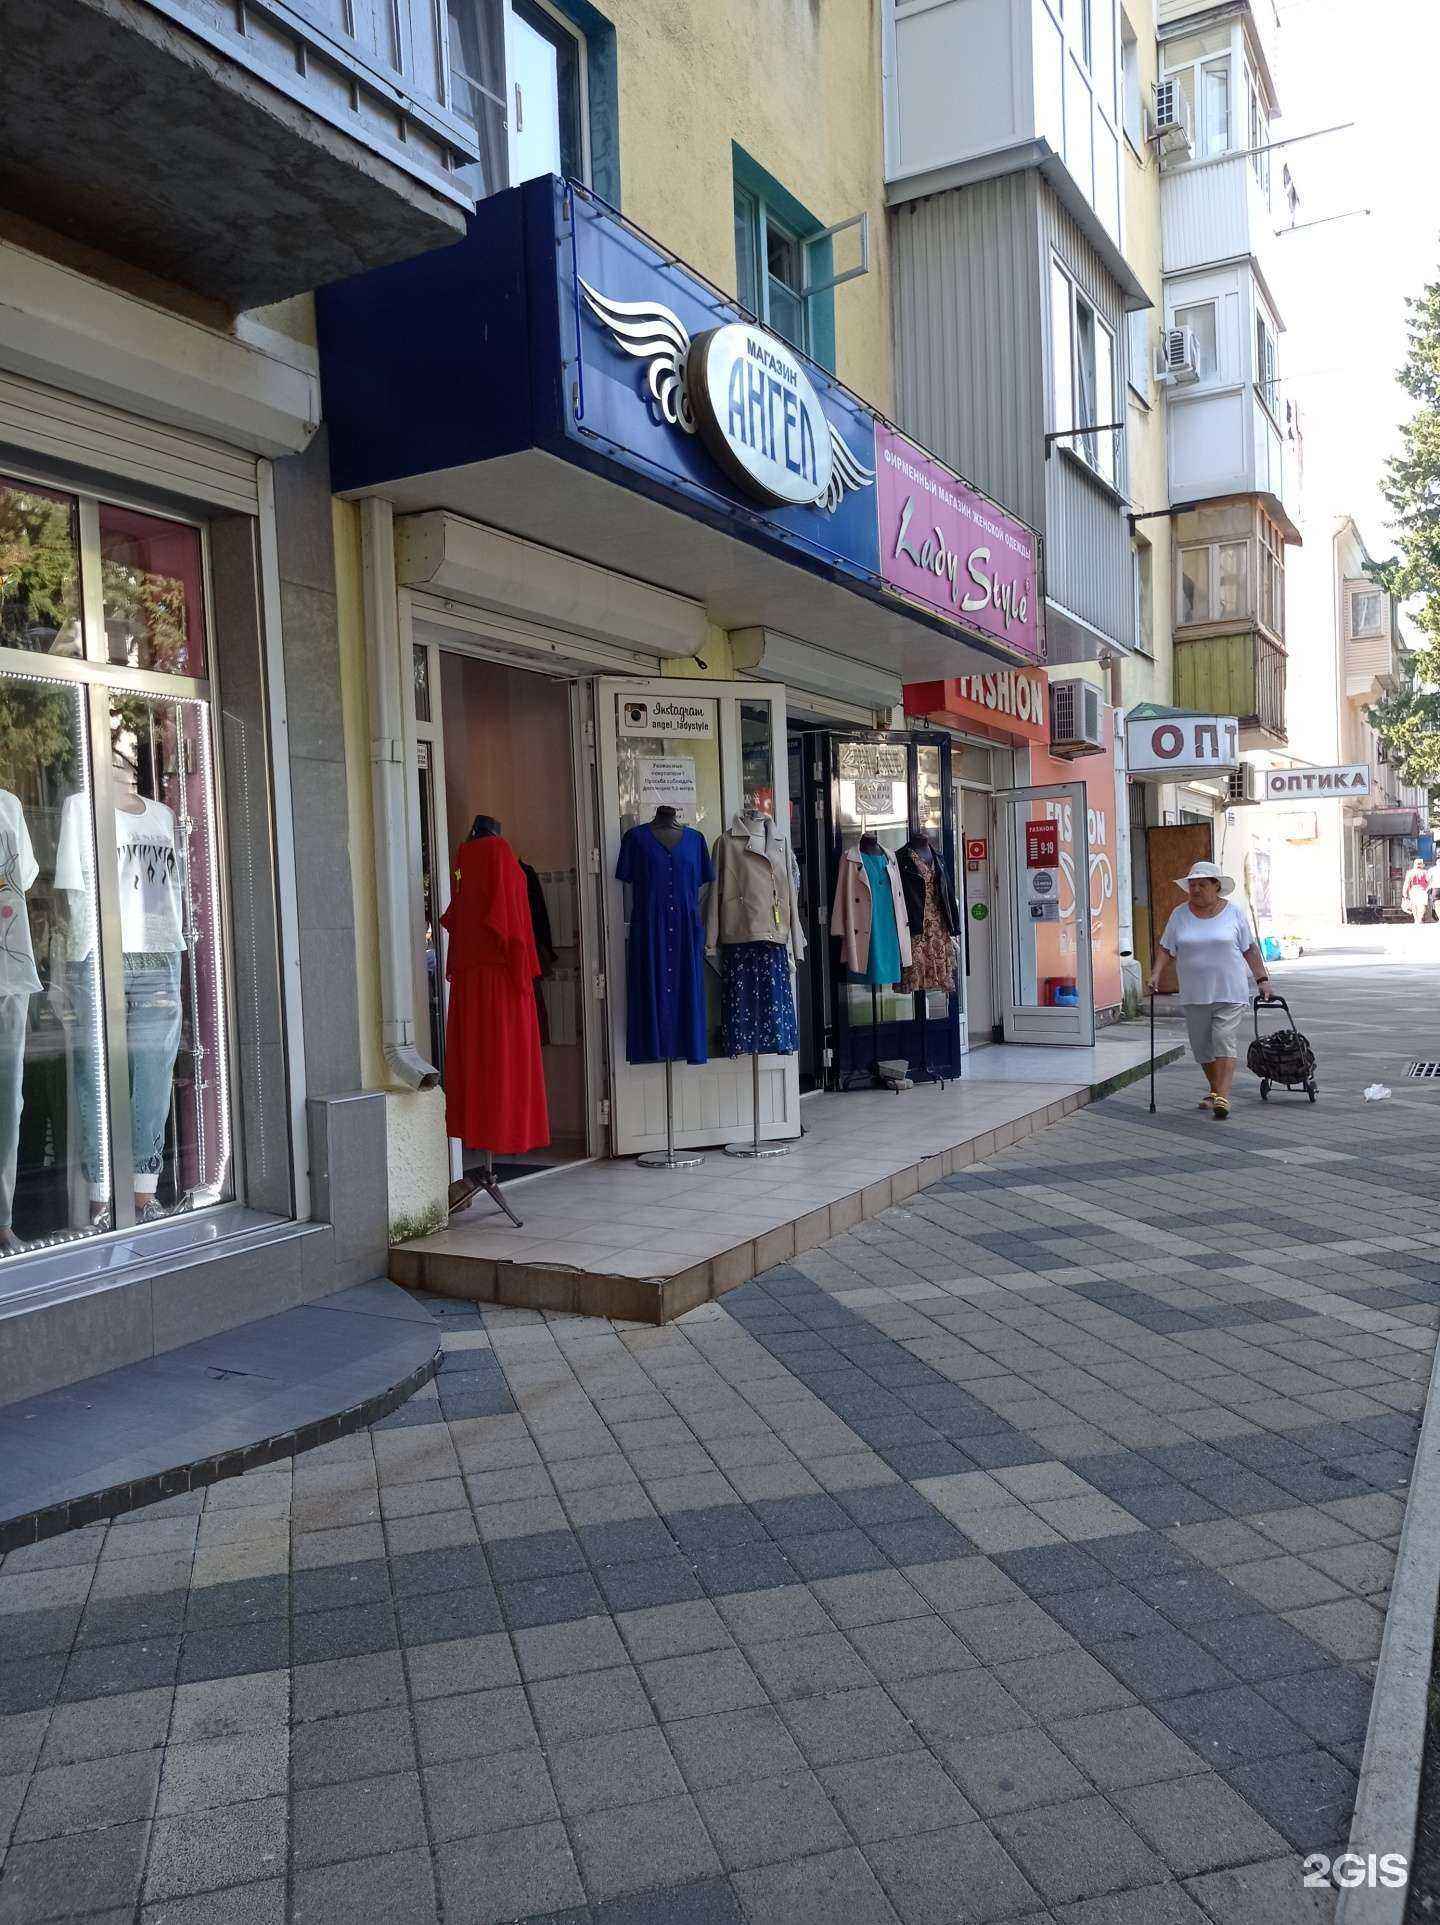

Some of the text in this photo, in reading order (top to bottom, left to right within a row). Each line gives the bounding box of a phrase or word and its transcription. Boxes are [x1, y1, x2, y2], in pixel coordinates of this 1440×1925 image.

[746, 337, 797, 387] МАГАЗИН
[728, 356, 818, 486] АНГЕЛ
[884, 449, 1031, 560] ФИРМЕННЫЙ МАГАЗИН ЖЕНСКОЙ ОДЕЖДЫ
[895, 495, 1028, 631] Lady Style
[652, 702, 705, 722] Instagram
[1270, 772, 1367, 793] ОПТИКА
[1040, 840, 1054, 855] 9-19
